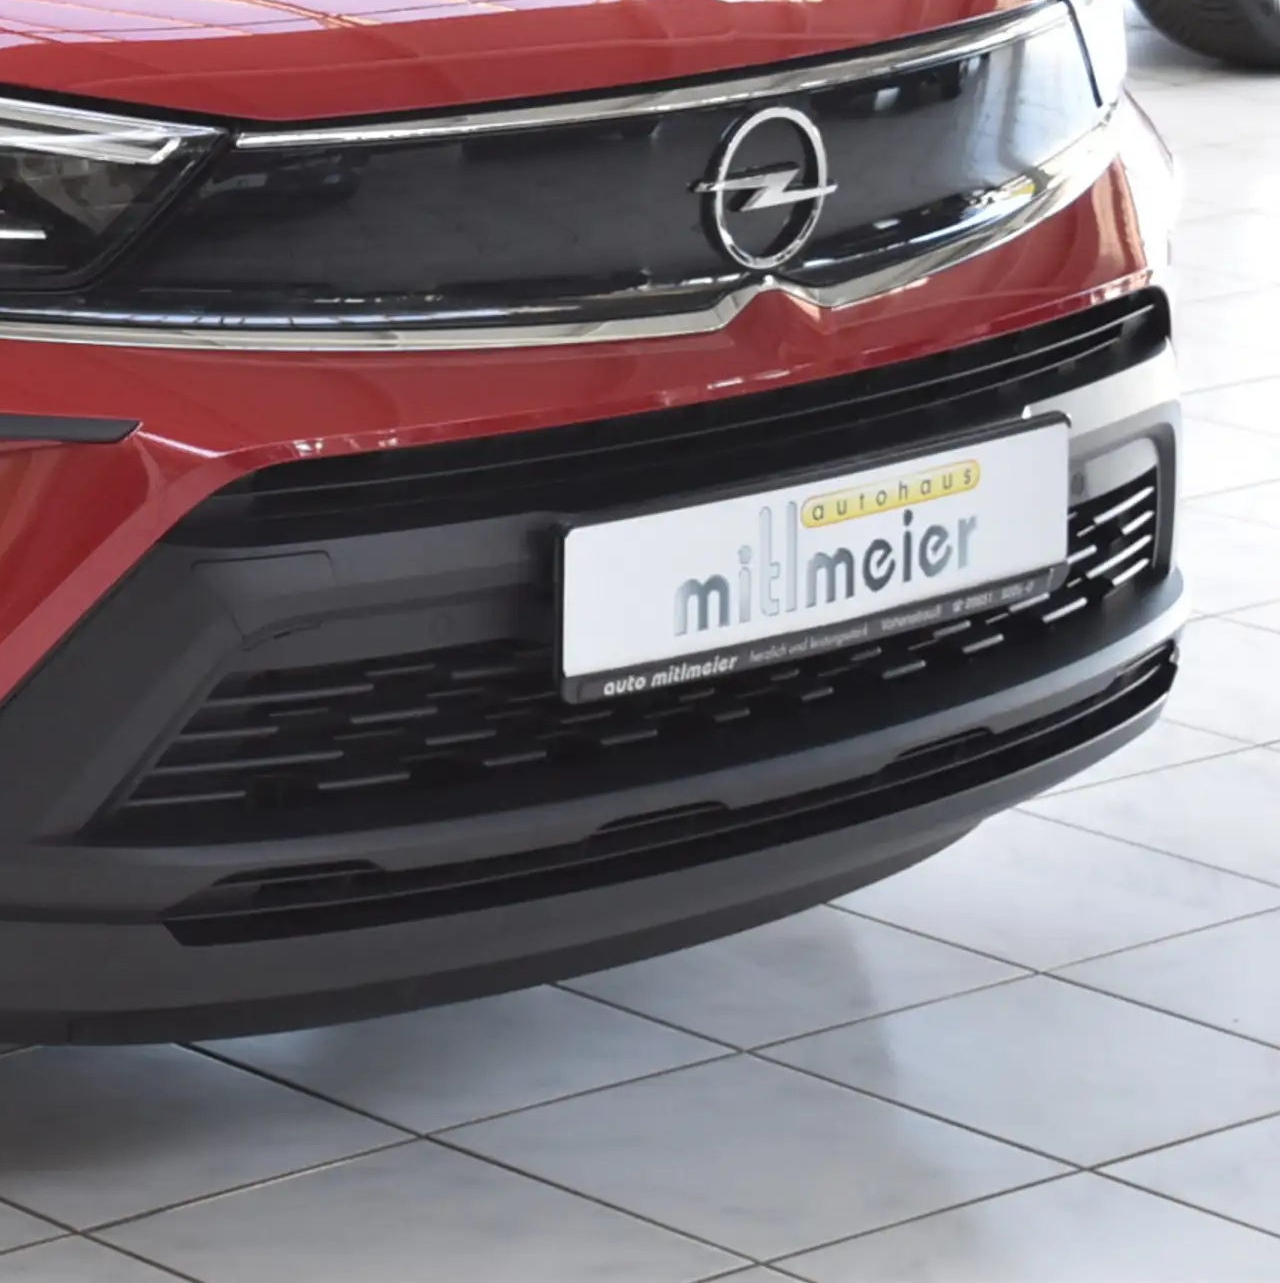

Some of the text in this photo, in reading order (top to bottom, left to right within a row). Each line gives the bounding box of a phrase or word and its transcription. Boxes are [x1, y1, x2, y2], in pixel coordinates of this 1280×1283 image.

[811, 467, 973, 522] autohaus
[674, 501, 978, 637] mitlmeier
[603, 674, 647, 697] auto
[651, 655, 739, 688] mitlmeier
